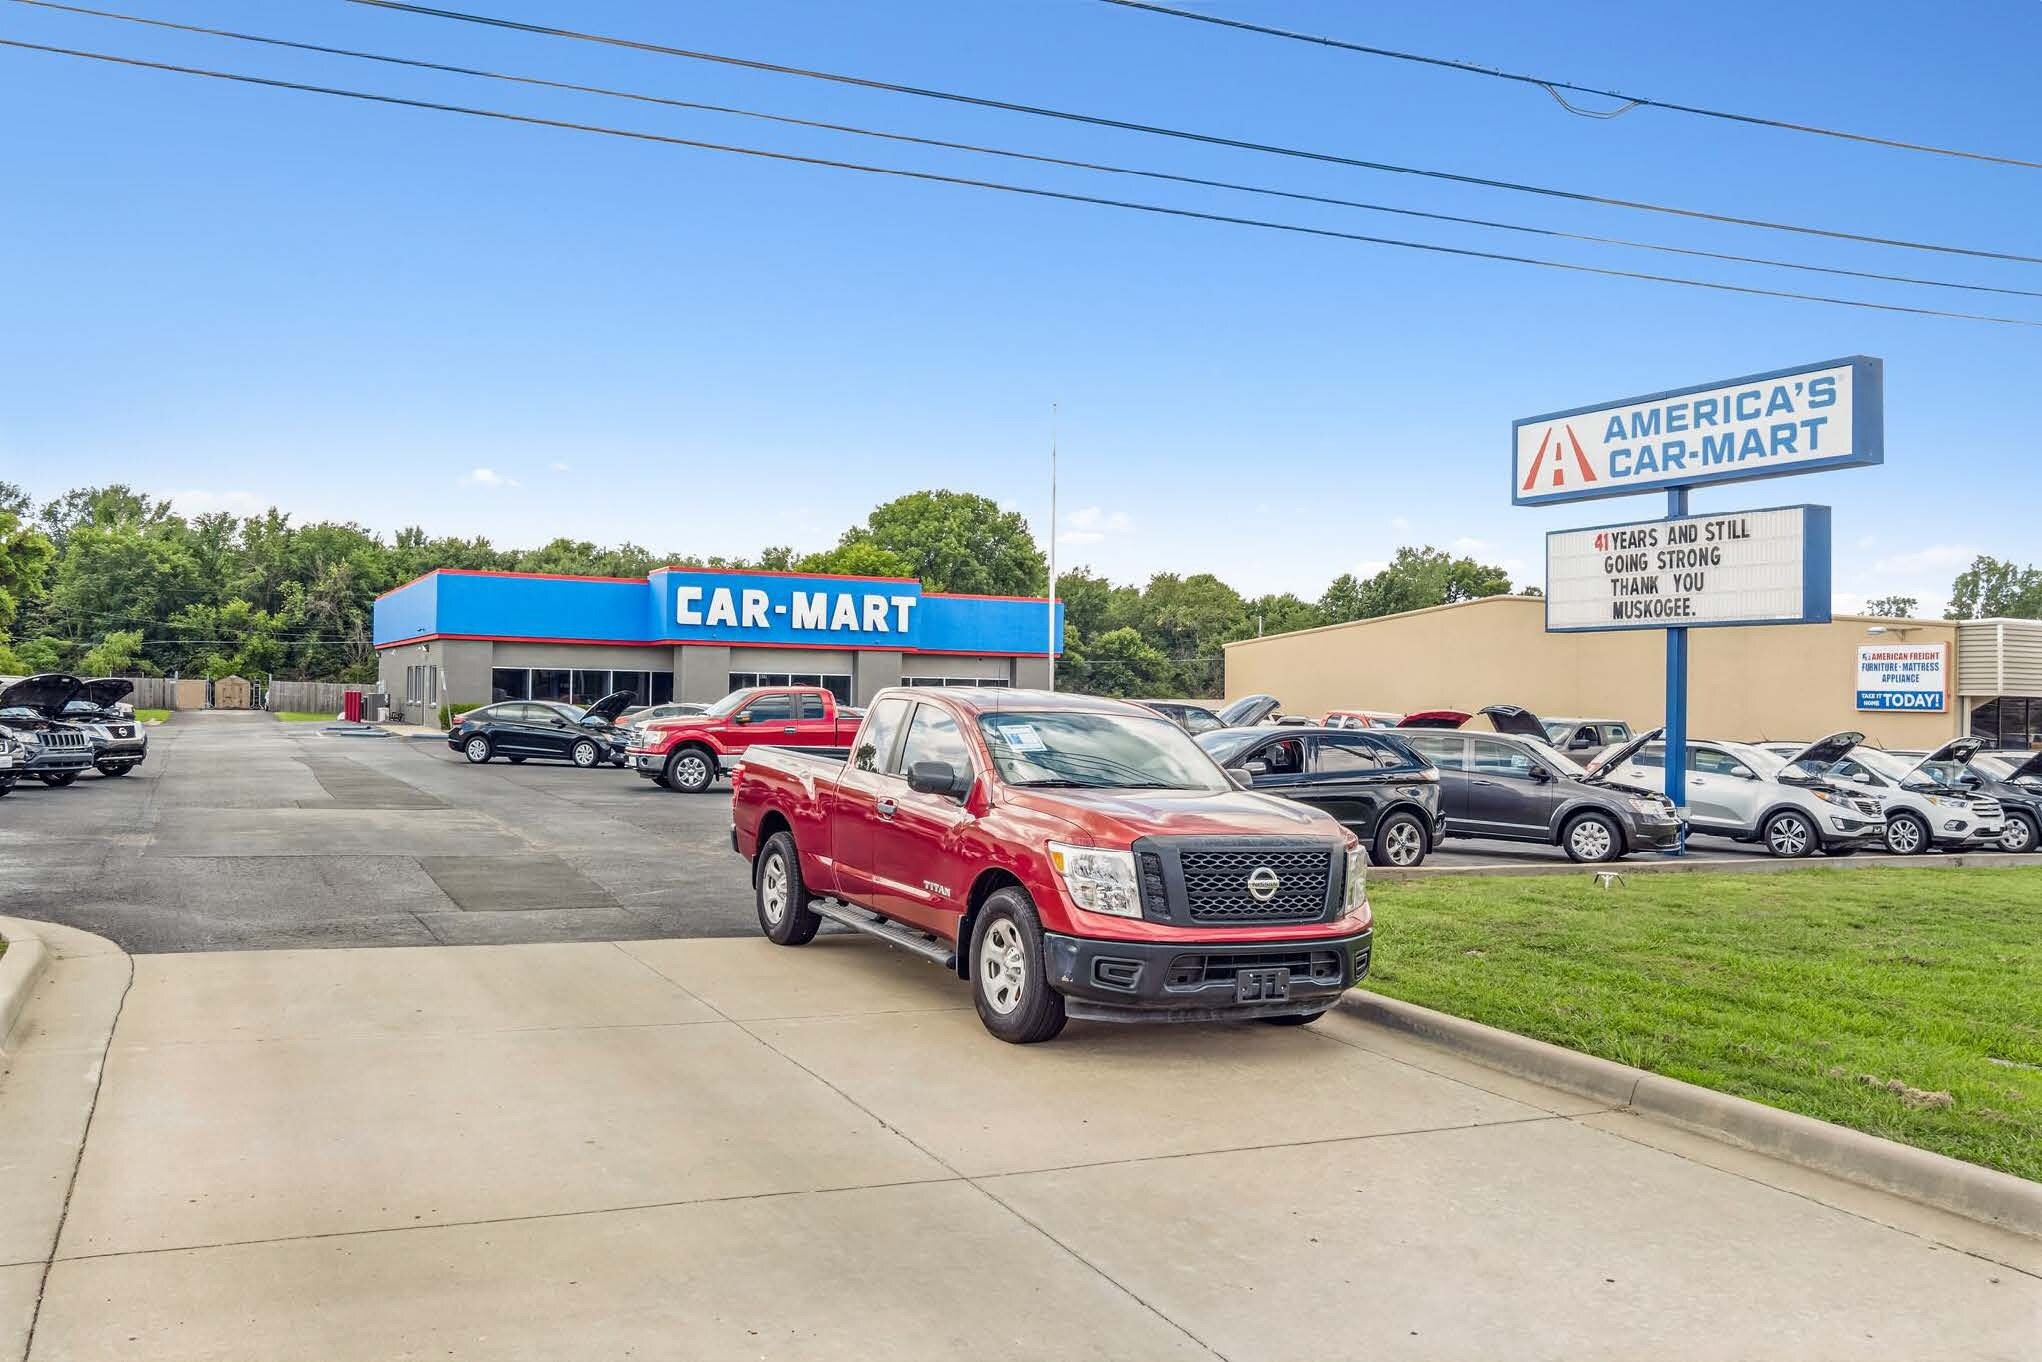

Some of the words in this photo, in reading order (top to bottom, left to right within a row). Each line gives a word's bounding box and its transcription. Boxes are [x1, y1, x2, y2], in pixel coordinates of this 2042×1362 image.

[1604, 376, 1837, 444] AMERICA'S
[1609, 416, 1828, 479] CAR-MART
[1594, 533, 1609, 552] 41
[1611, 528, 1658, 551] YEARS
[1667, 524, 1698, 546] AND
[1705, 519, 1750, 542] STILL
[1604, 552, 1648, 575] GOING
[1657, 546, 1721, 571] STRONG
[1611, 575, 1659, 597] THANK
[1673, 572, 1705, 593] YOU
[676, 586, 917, 633] CAR-MART
[1613, 597, 1697, 620] MUSKOGEE.
[1861, 662, 1898, 672] FURNITURE
[1902, 662, 1939, 672] MATTRESS
[1871, 652, 1908, 661] AMERICAN
[1910, 652, 1939, 661] FREIGHT
[1882, 673, 1920, 683] APPLIANCE
[1883, 693, 1940, 707] TODAY!
[923, 880, 951, 897] TITAN
